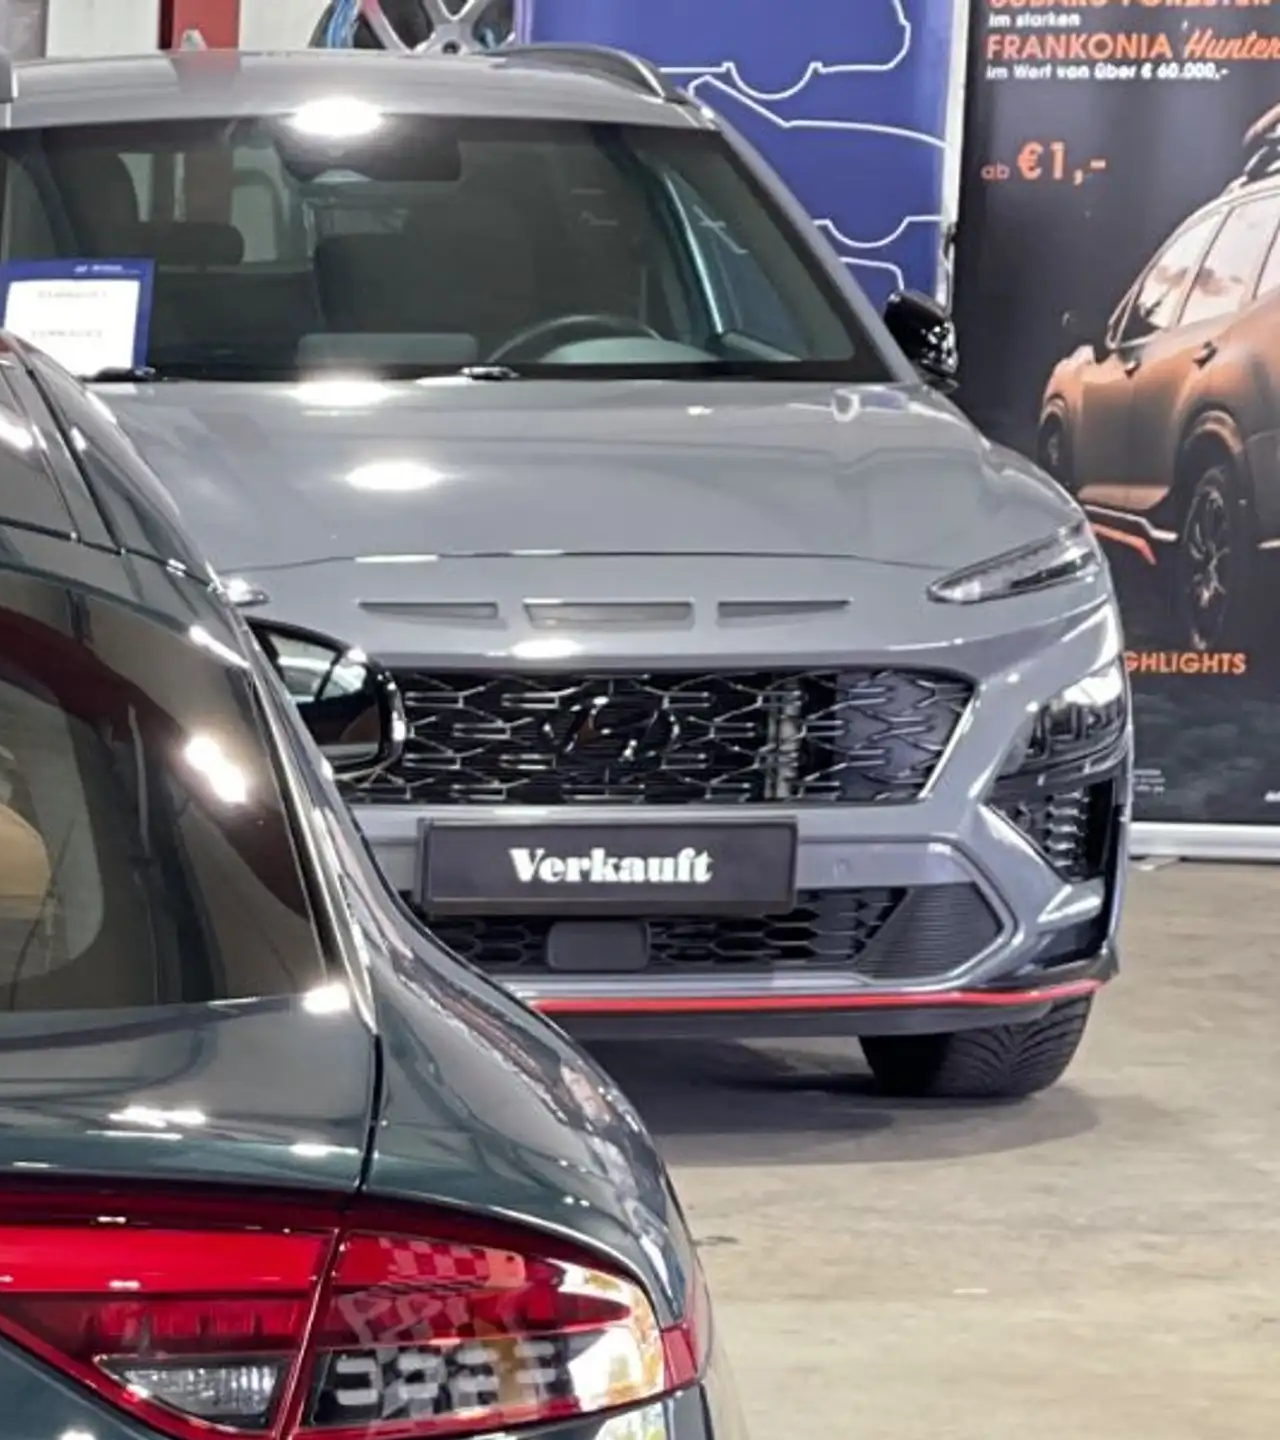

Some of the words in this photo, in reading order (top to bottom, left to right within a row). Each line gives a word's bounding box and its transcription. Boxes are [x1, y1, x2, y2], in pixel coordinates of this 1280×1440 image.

[986, 32, 1172, 60] FRANKONIA
[980, 161, 1011, 180] ab
[1124, 652, 1247, 676] GHLIGHTS
[508, 847, 715, 884] Verkauft
